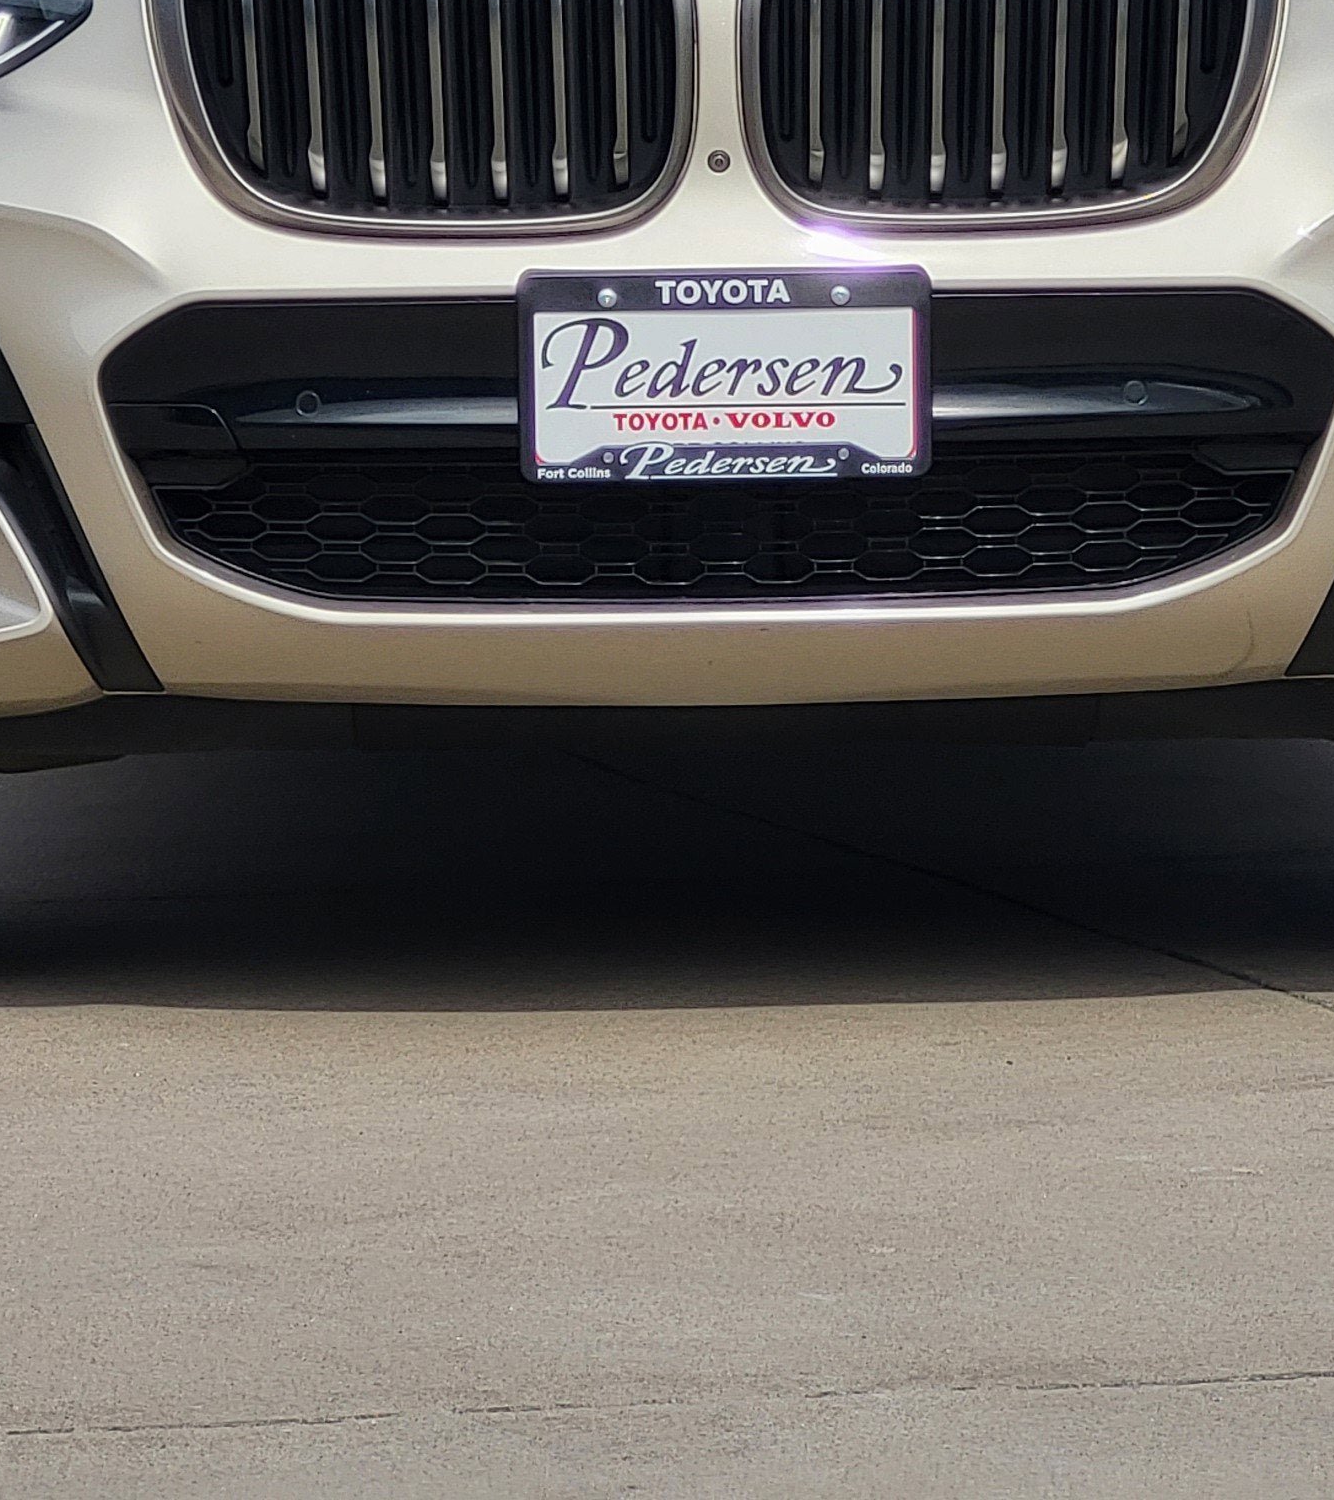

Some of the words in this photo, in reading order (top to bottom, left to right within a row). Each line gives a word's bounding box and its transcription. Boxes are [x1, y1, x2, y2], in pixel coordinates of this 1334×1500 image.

[655, 278, 791, 305] TOYOTA
[541, 317, 903, 410] Pedersen
[612, 412, 708, 431] TOYOTA
[724, 411, 837, 429] VOLVO
[619, 441, 837, 480] Pedersen
[860, 462, 914, 474] Colorado
[536, 467, 565, 480] Fort
[567, 466, 612, 479] Collins
